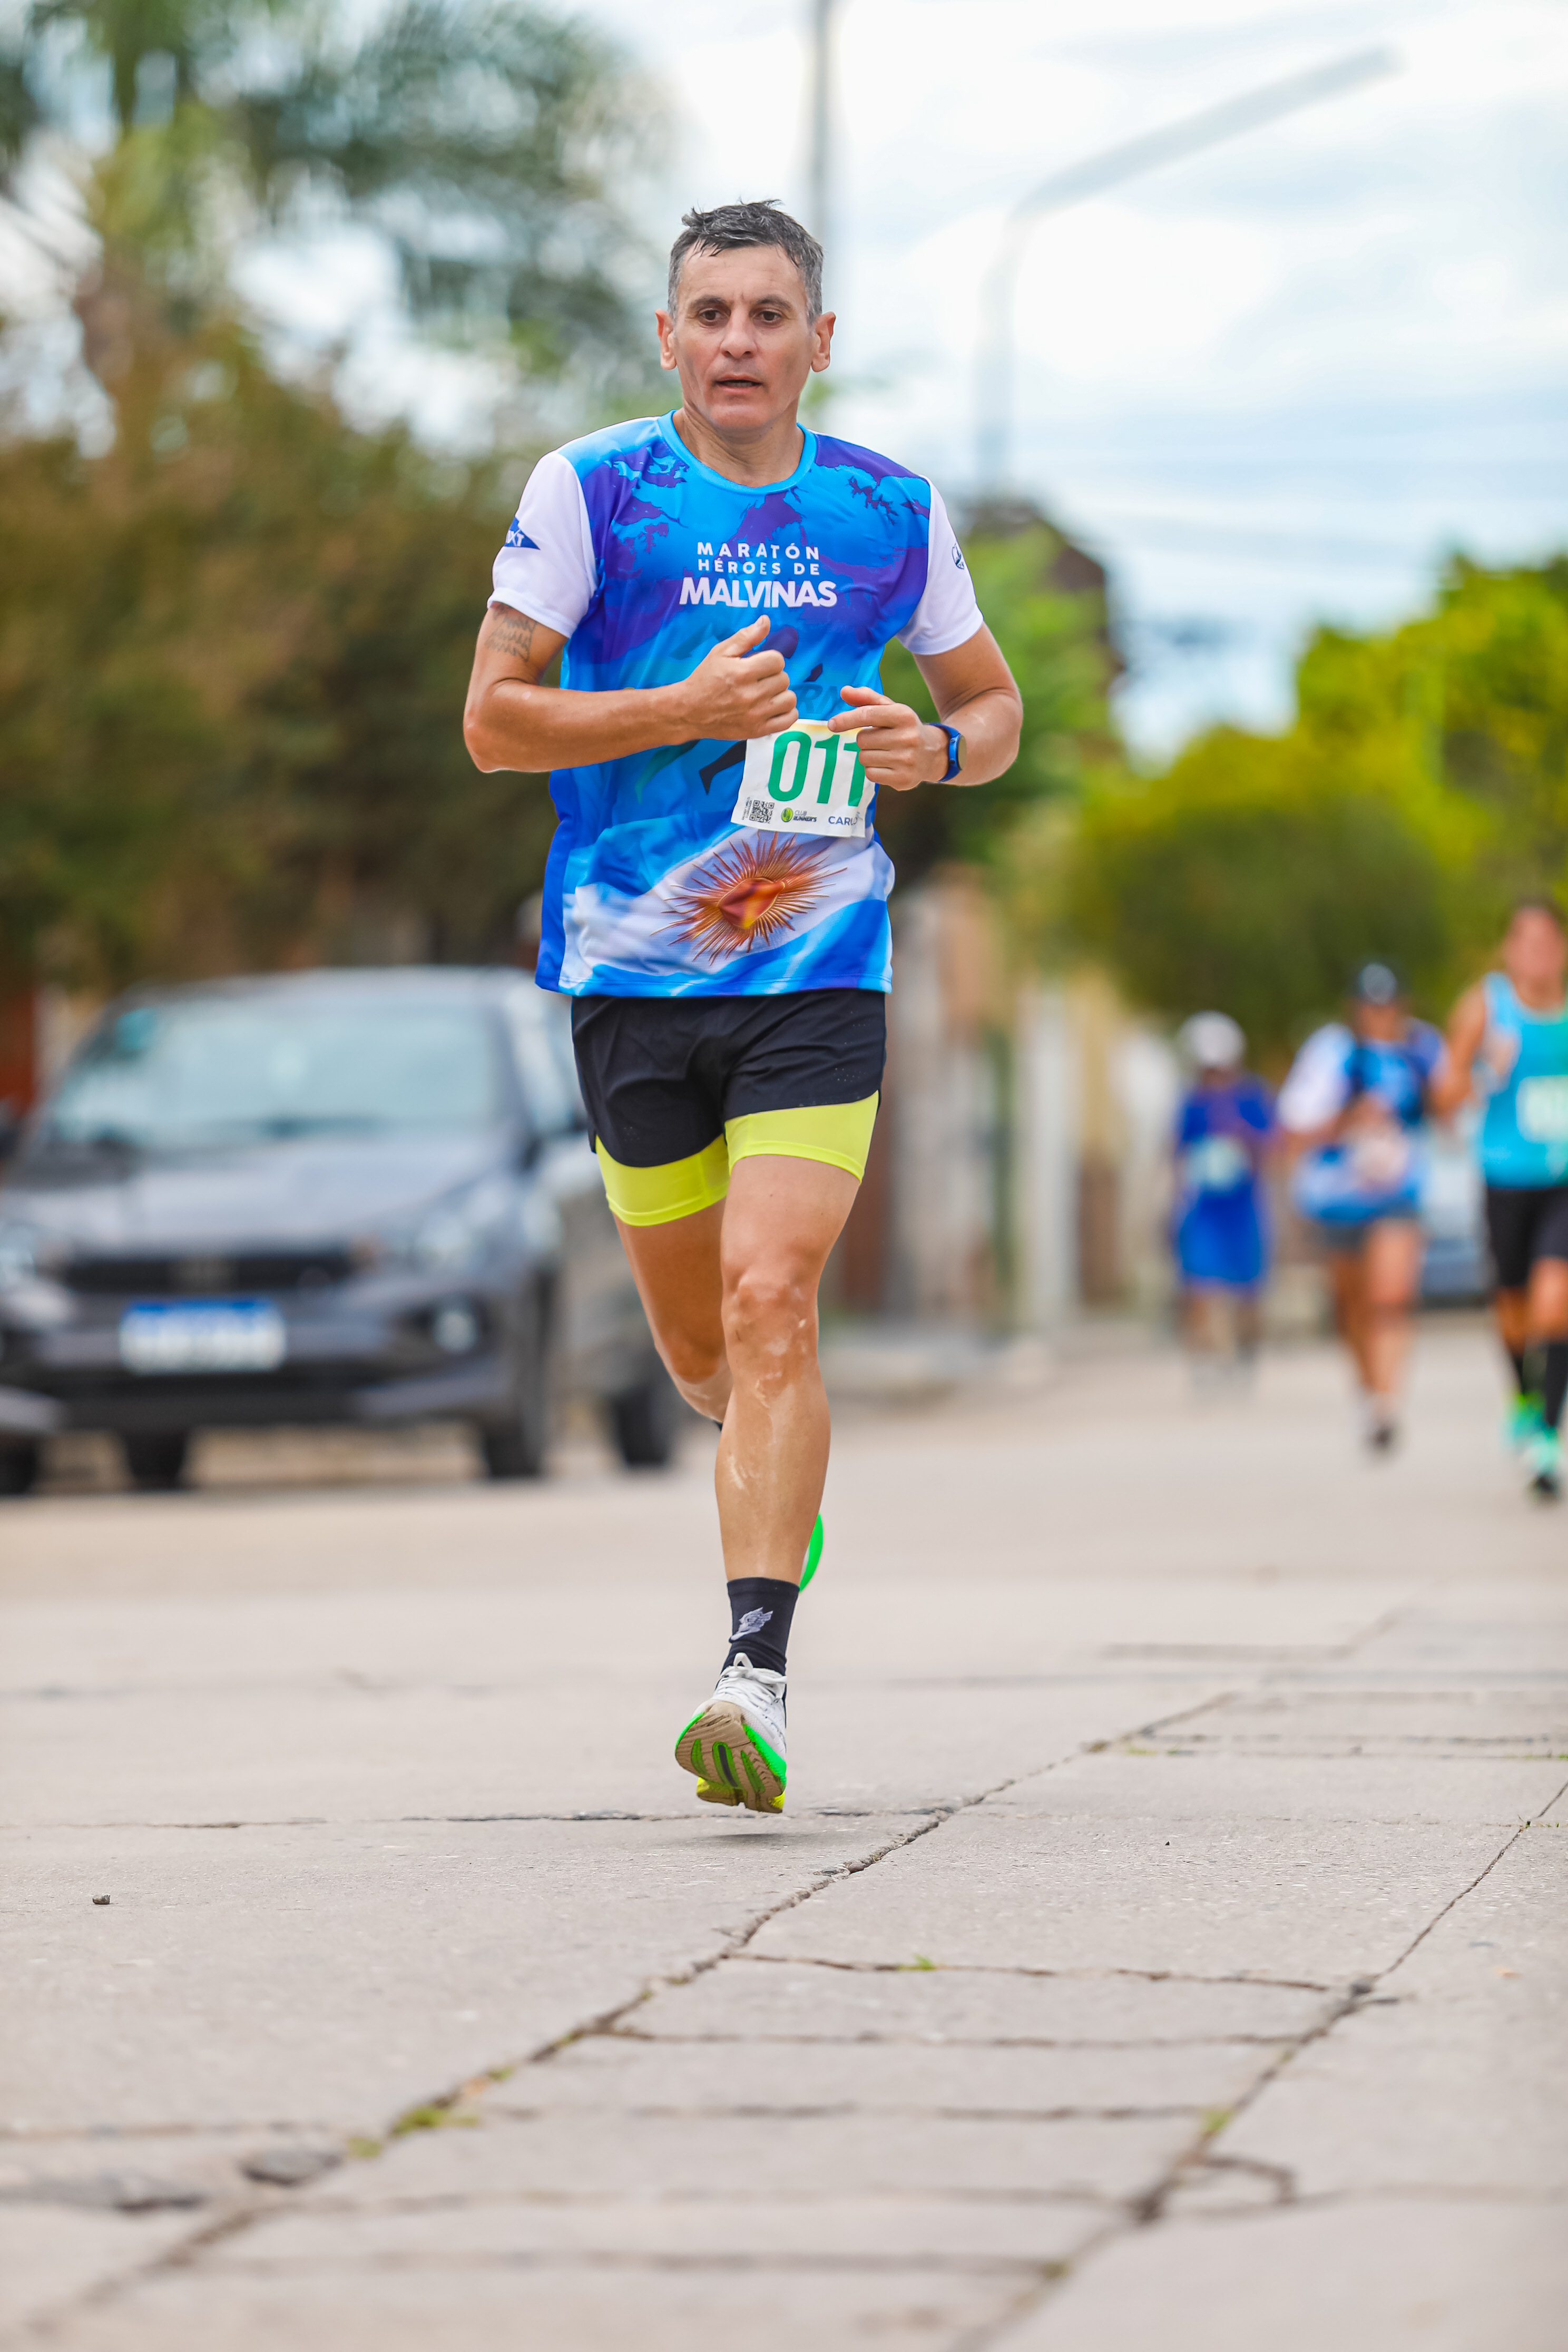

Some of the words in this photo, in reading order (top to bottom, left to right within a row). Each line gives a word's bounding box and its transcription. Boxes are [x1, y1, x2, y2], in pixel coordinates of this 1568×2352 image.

[697, 542, 819, 560] MARATÓN
[698, 558, 781, 574] HÉROES
[794, 563, 820, 575] DE
[679, 577, 837, 607] MALVINAS
